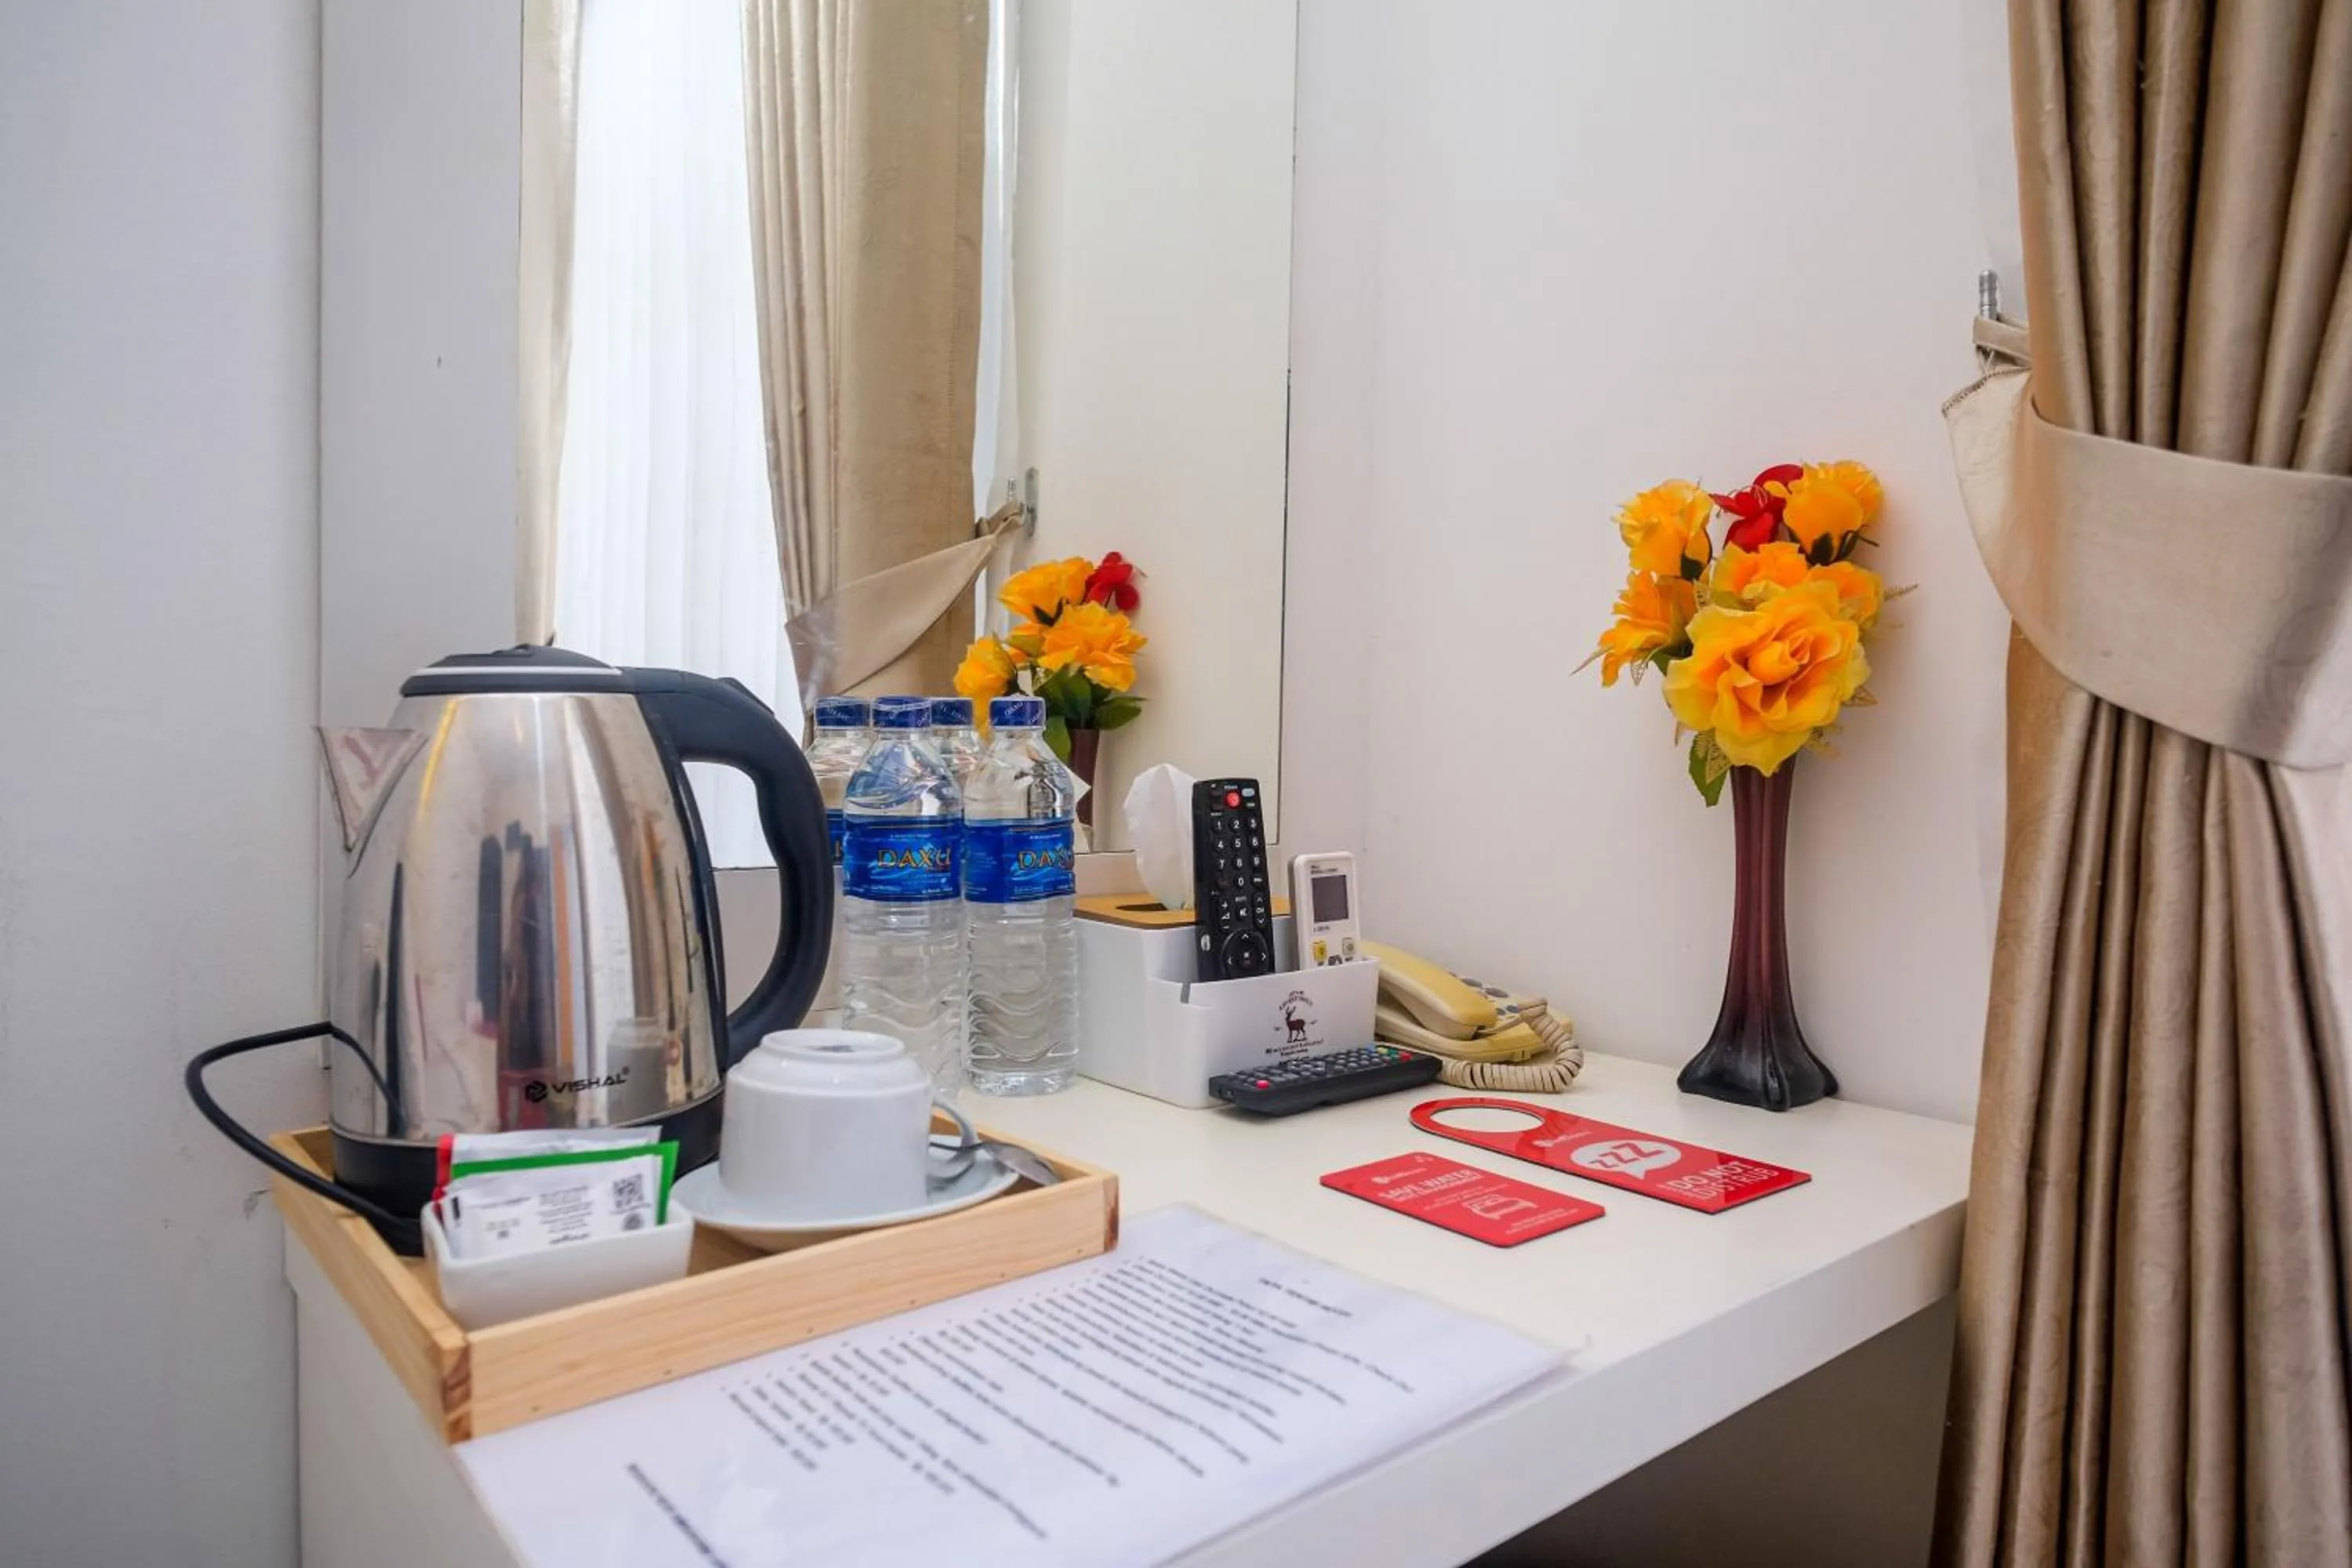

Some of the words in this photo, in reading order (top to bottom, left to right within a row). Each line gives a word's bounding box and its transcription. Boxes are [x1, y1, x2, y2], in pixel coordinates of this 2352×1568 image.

[1217, 820, 1222, 829] 1
[1233, 819, 1240, 829] 2
[1250, 818, 1256, 828] 3
[1218, 840, 1224, 849] 4
[1235, 838, 1241, 848] 5
[1252, 837, 1258, 846] 6
[877, 847, 951, 867] DAXU
[1219, 858, 1225, 869] 7
[1236, 858, 1243, 868] 8
[1254, 857, 1260, 866] 9
[1238, 877, 1244, 887] 0
[551, 1073, 626, 1093] VISHAL
